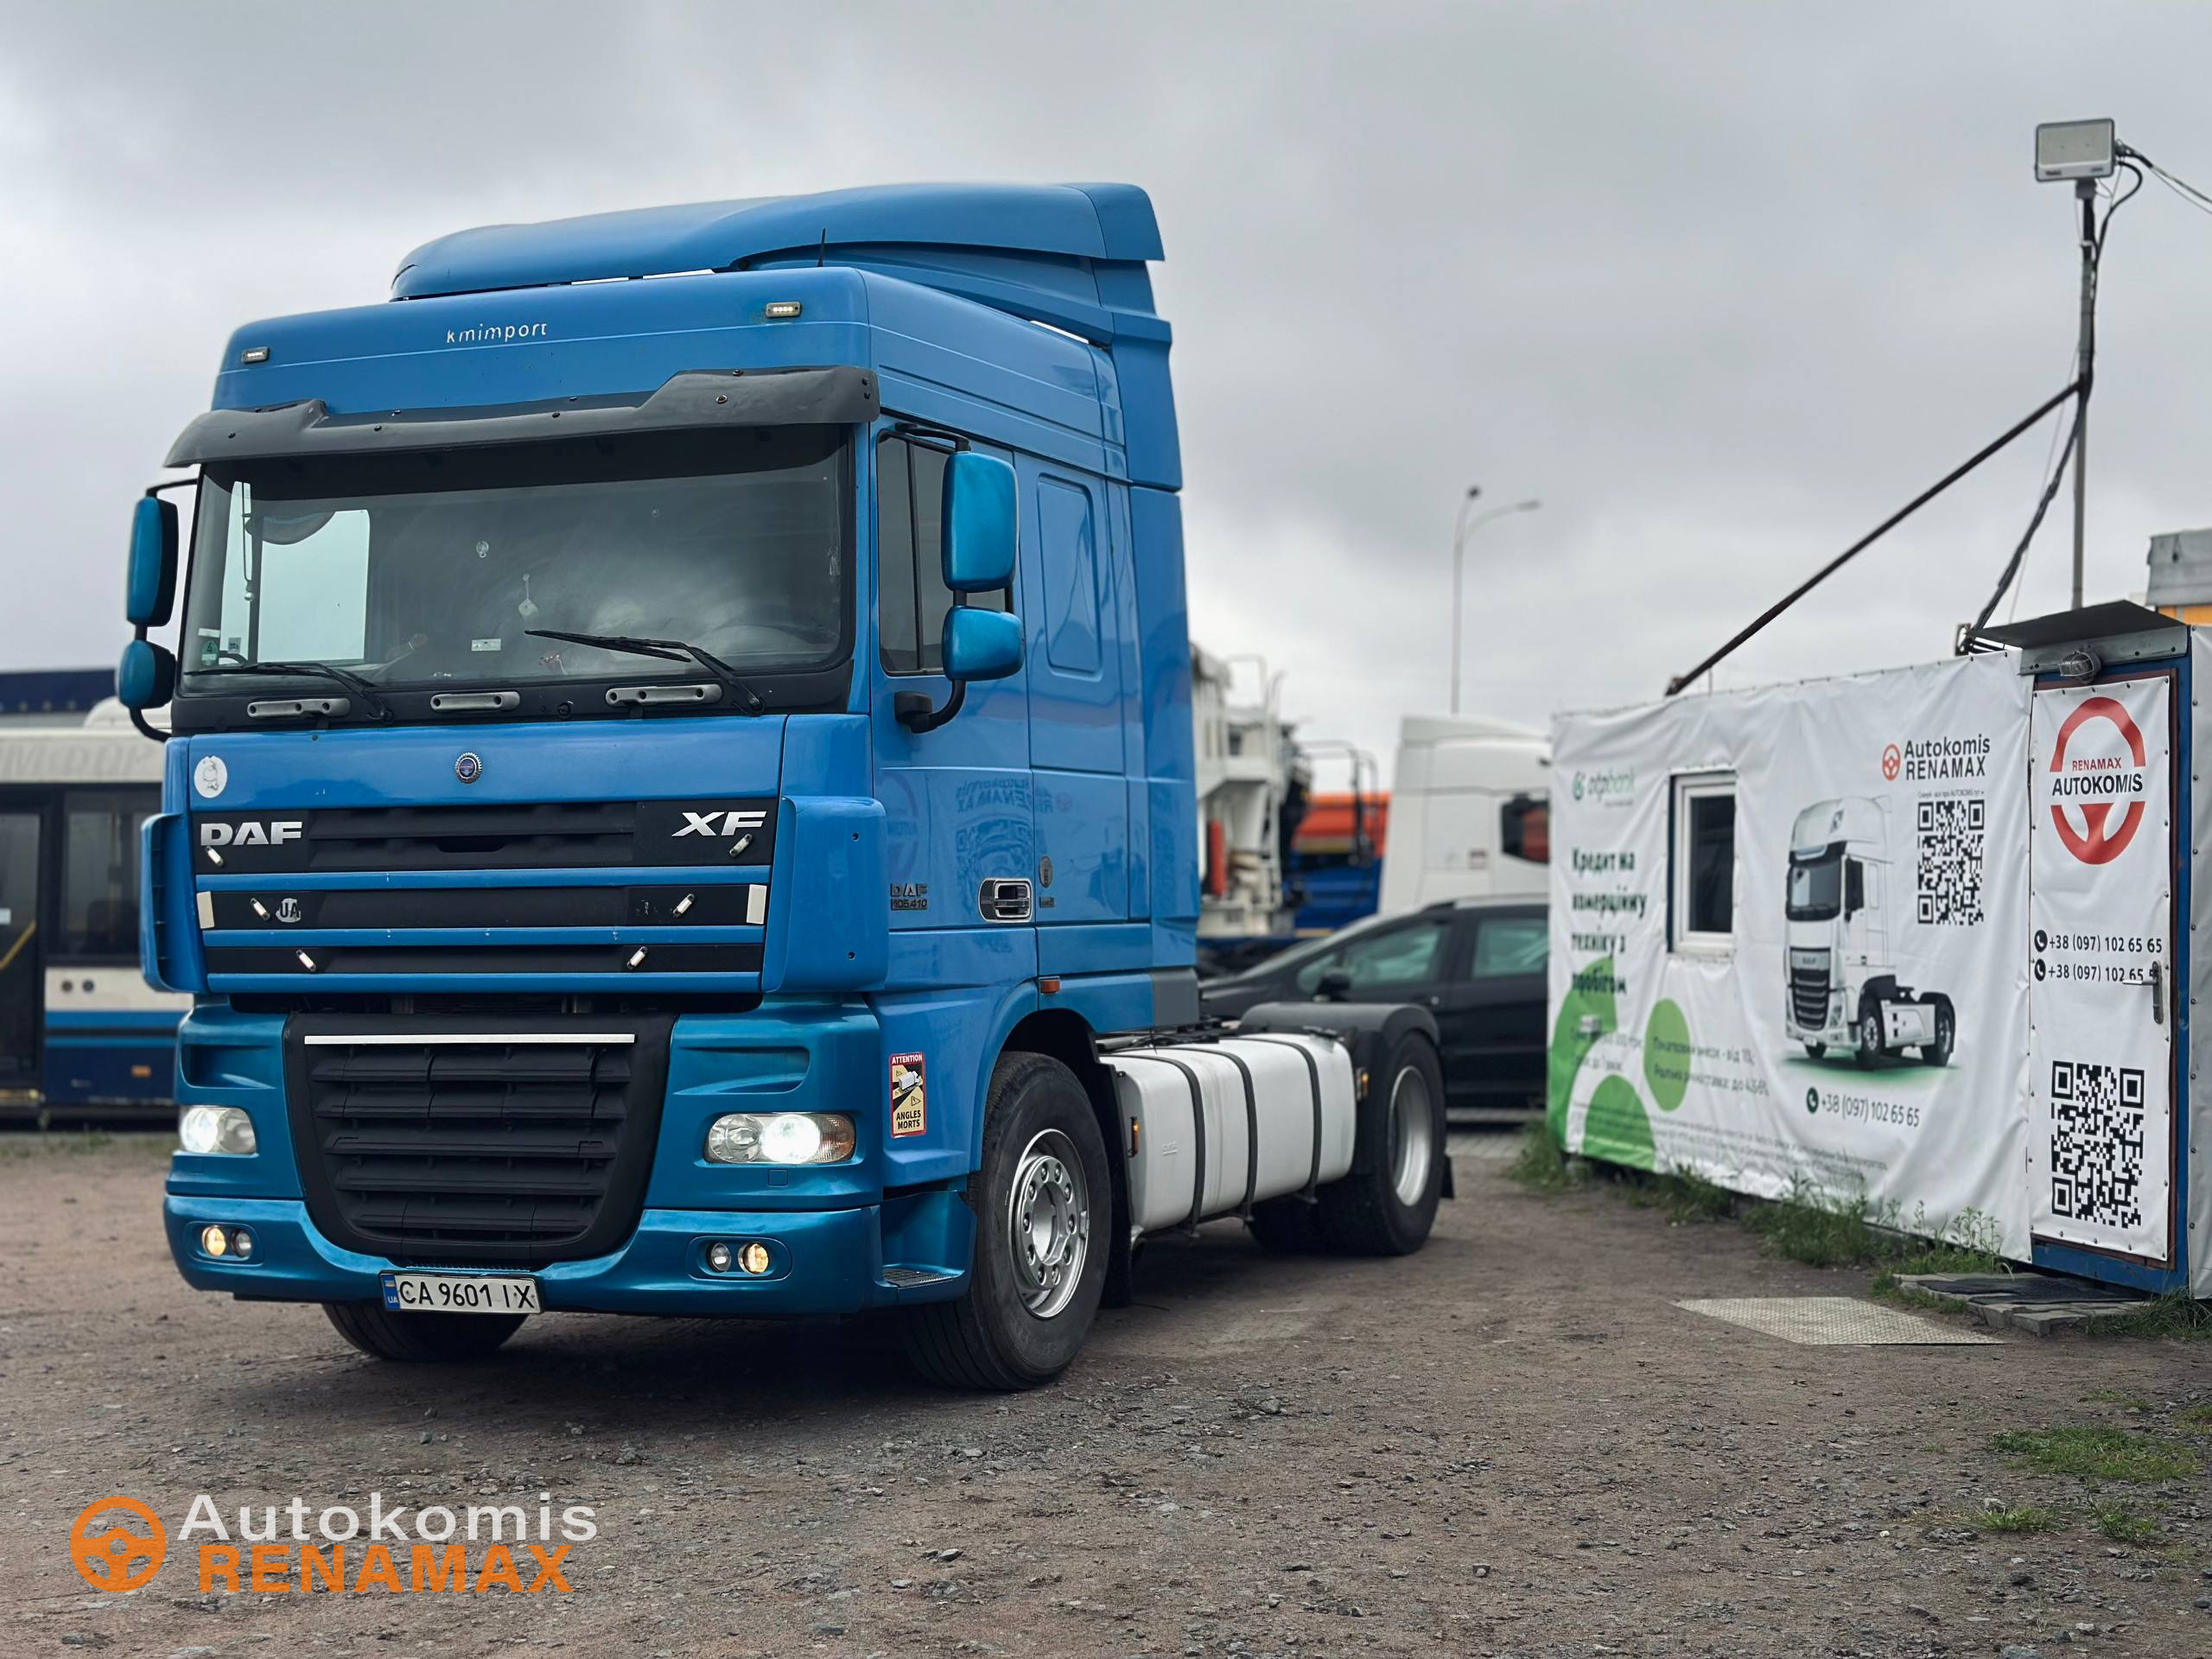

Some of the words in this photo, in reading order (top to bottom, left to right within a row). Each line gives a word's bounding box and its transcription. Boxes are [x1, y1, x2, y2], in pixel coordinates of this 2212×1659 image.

[447, 323, 547, 343] kmimport
[1904, 734, 1991, 759] Autokomis
[1906, 756, 1986, 780] RENAMAX
[2072, 757, 2121, 772] RENAMAX
[2052, 773, 2143, 796] AUTOKOMIS
[671, 811, 767, 836] XF
[200, 822, 302, 846] DAF
[890, 883, 927, 898] DAF
[279, 903, 300, 918] UA
[2049, 934, 2069, 950] +38
[2073, 933, 2101, 952] (097)
[2105, 937, 2125, 951] 102
[2128, 938, 2143, 952] 65
[2146, 938, 2162, 953] 65
[2048, 964, 2069, 979] +38
[2073, 963, 2101, 982] (097)
[2106, 967, 2125, 982] 102
[2128, 968, 2144, 981] 65
[892, 1054, 923, 1065] ATTENTION
[896, 1109, 921, 1121] ANGLES
[1821, 1093, 1840, 1114] +38
[1841, 1094, 1869, 1125] (097)
[1872, 1101, 1888, 1122] 102
[1891, 1104, 1904, 1125] 65
[1906, 1107, 1920, 1127] 65
[898, 1119, 920, 1129] MORTS
[400, 1281, 434, 1306] CA
[438, 1282, 493, 1307] 9601
[503, 1285, 535, 1309] IX
